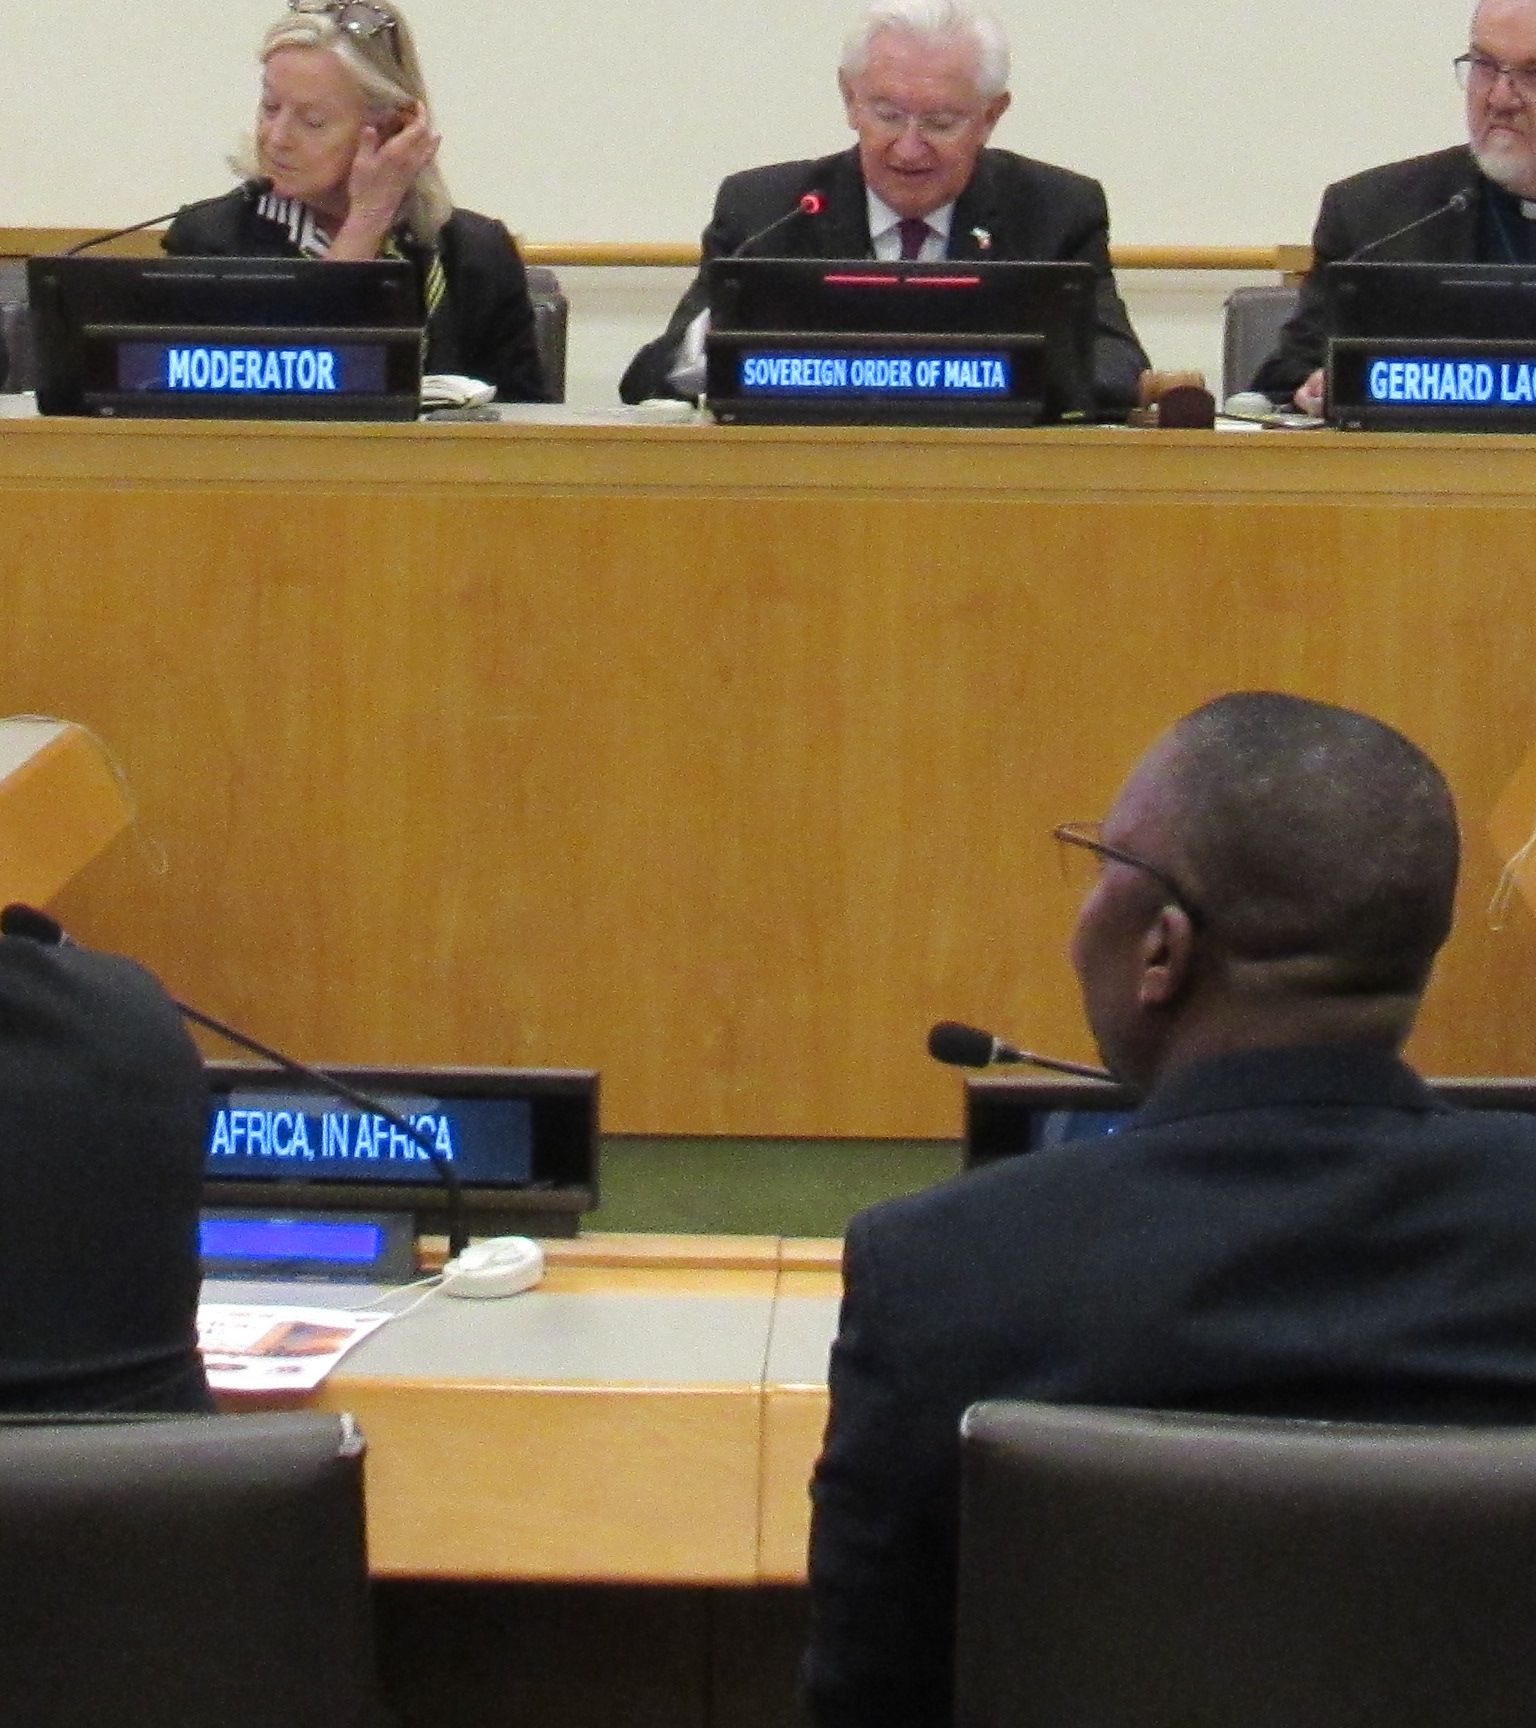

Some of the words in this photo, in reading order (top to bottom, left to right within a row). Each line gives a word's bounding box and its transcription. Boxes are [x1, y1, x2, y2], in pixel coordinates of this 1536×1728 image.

[168, 348, 336, 390] MODERATOR
[743, 358, 847, 387] SOVEREIGN
[850, 359, 913, 387] ORDER
[915, 360, 941, 388] OF
[943, 360, 1005, 388] MALTA
[1369, 361, 1493, 401] GERHARD
[210, 1110, 314, 1161] AFRICA,
[321, 1113, 350, 1157] IN
